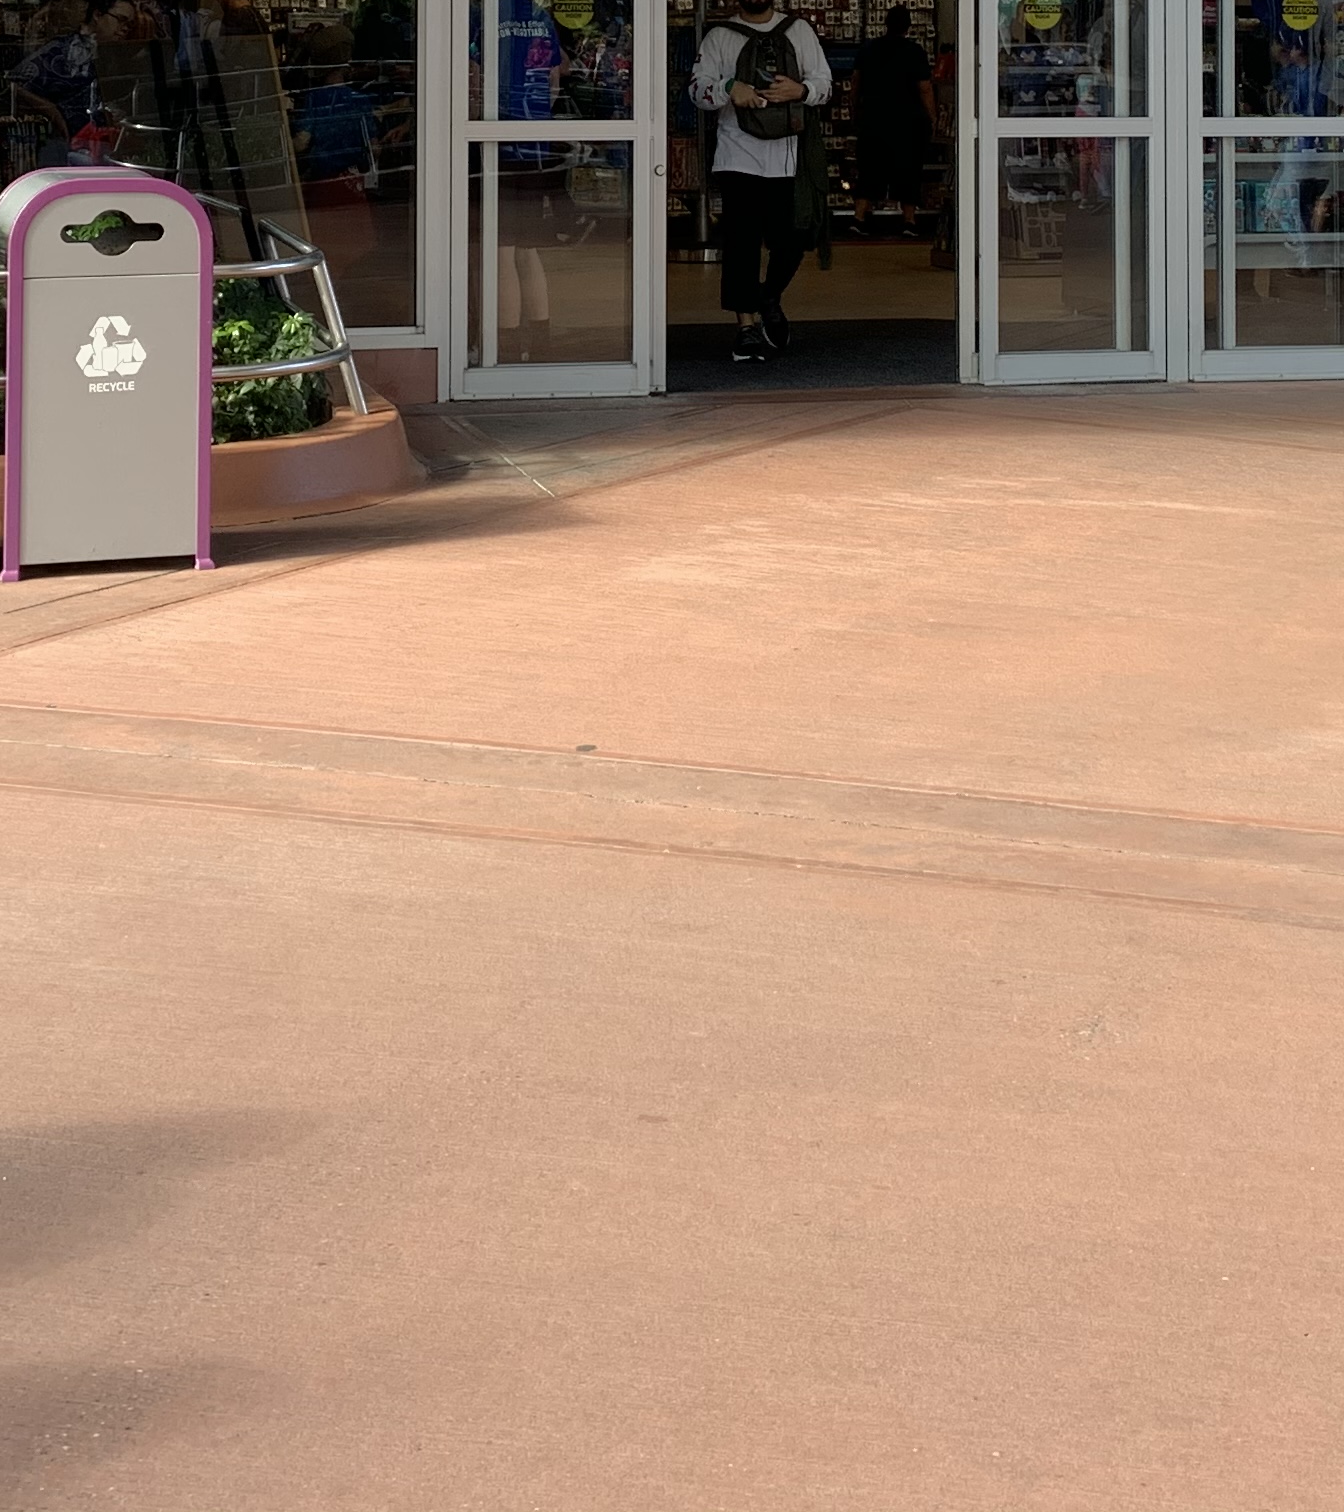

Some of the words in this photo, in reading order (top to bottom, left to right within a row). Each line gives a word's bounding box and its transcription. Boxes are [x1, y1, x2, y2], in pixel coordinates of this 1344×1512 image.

[554, 3, 593, 11] CAUTION
[1025, 5, 1061, 13] CAUTION
[1283, 6, 1318, 14] CAUTION
[89, 380, 136, 393] RECYCLE
